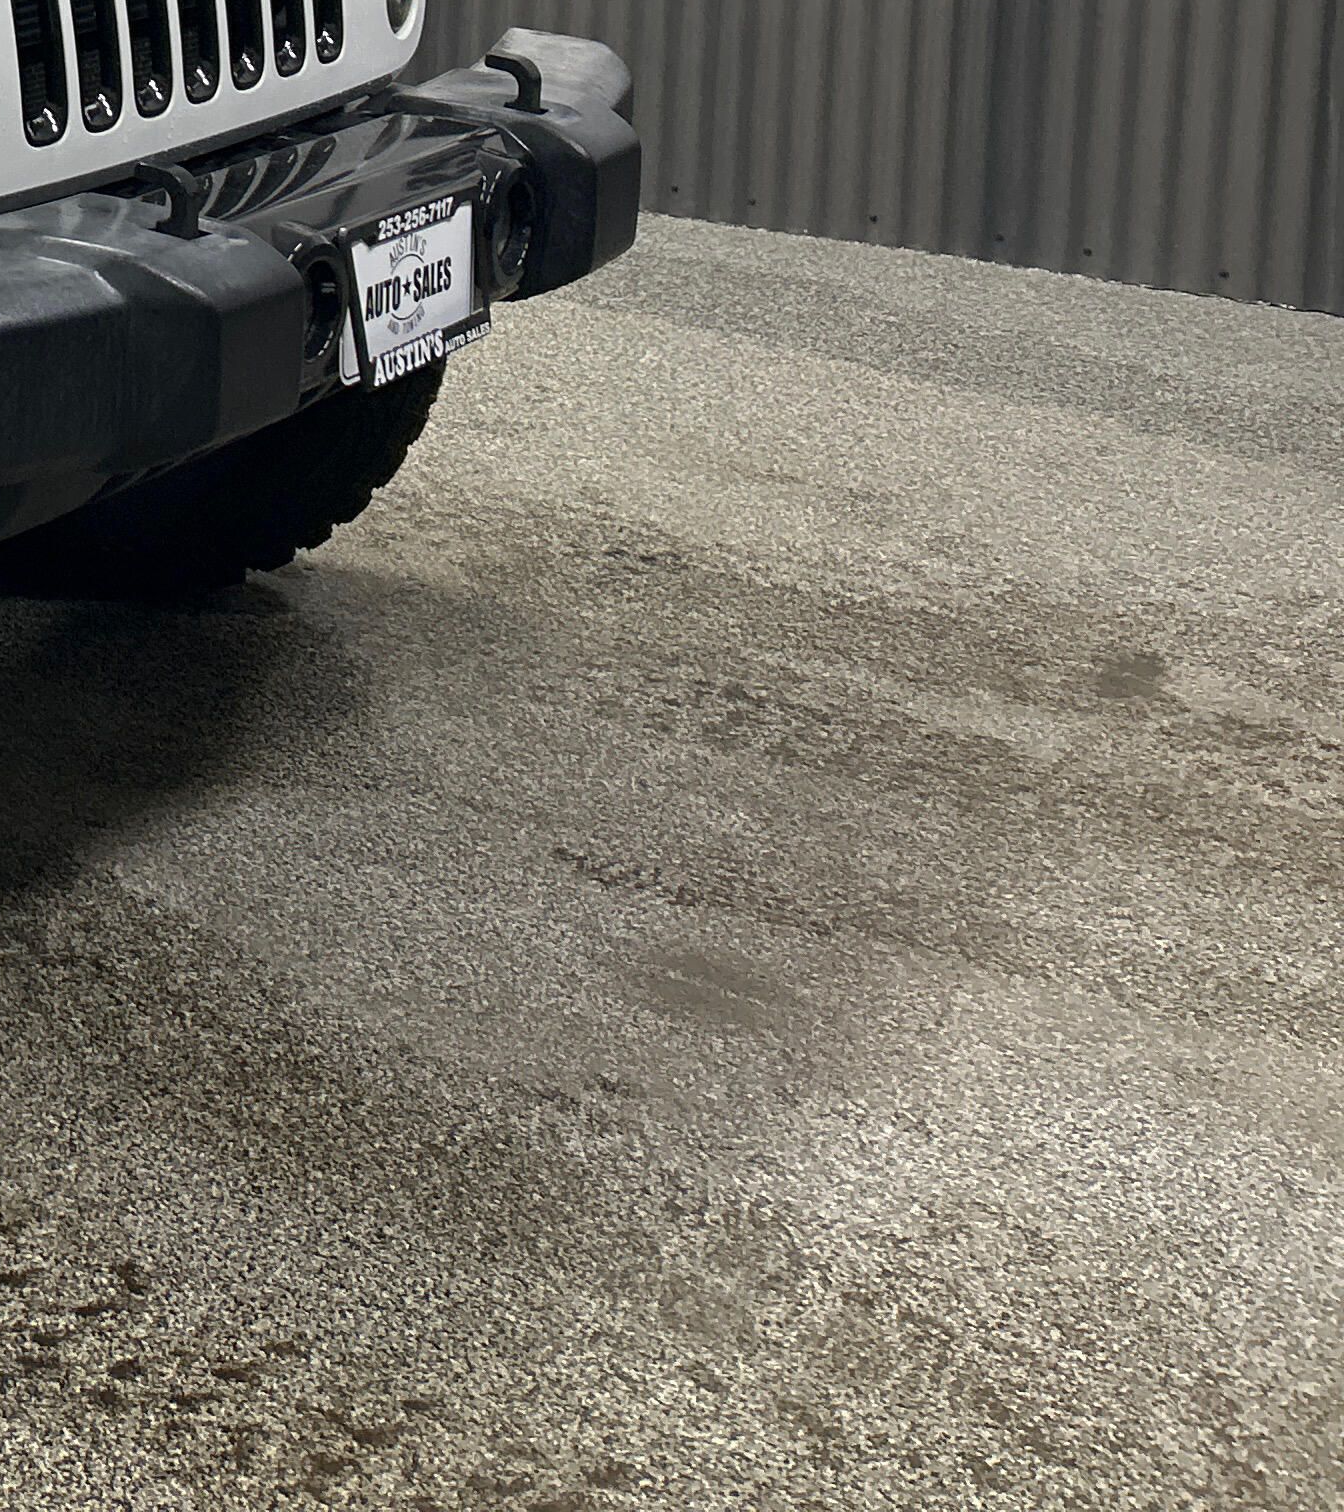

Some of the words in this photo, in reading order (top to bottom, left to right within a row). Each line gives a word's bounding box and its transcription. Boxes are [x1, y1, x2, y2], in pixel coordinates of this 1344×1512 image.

[378, 196, 454, 240] 253-256-7117
[365, 276, 401, 321] AUTO
[413, 256, 452, 303] SALES
[374, 329, 443, 387] AUSTIN'S
[444, 334, 466, 355] AUTO
[466, 321, 491, 342] SALES
